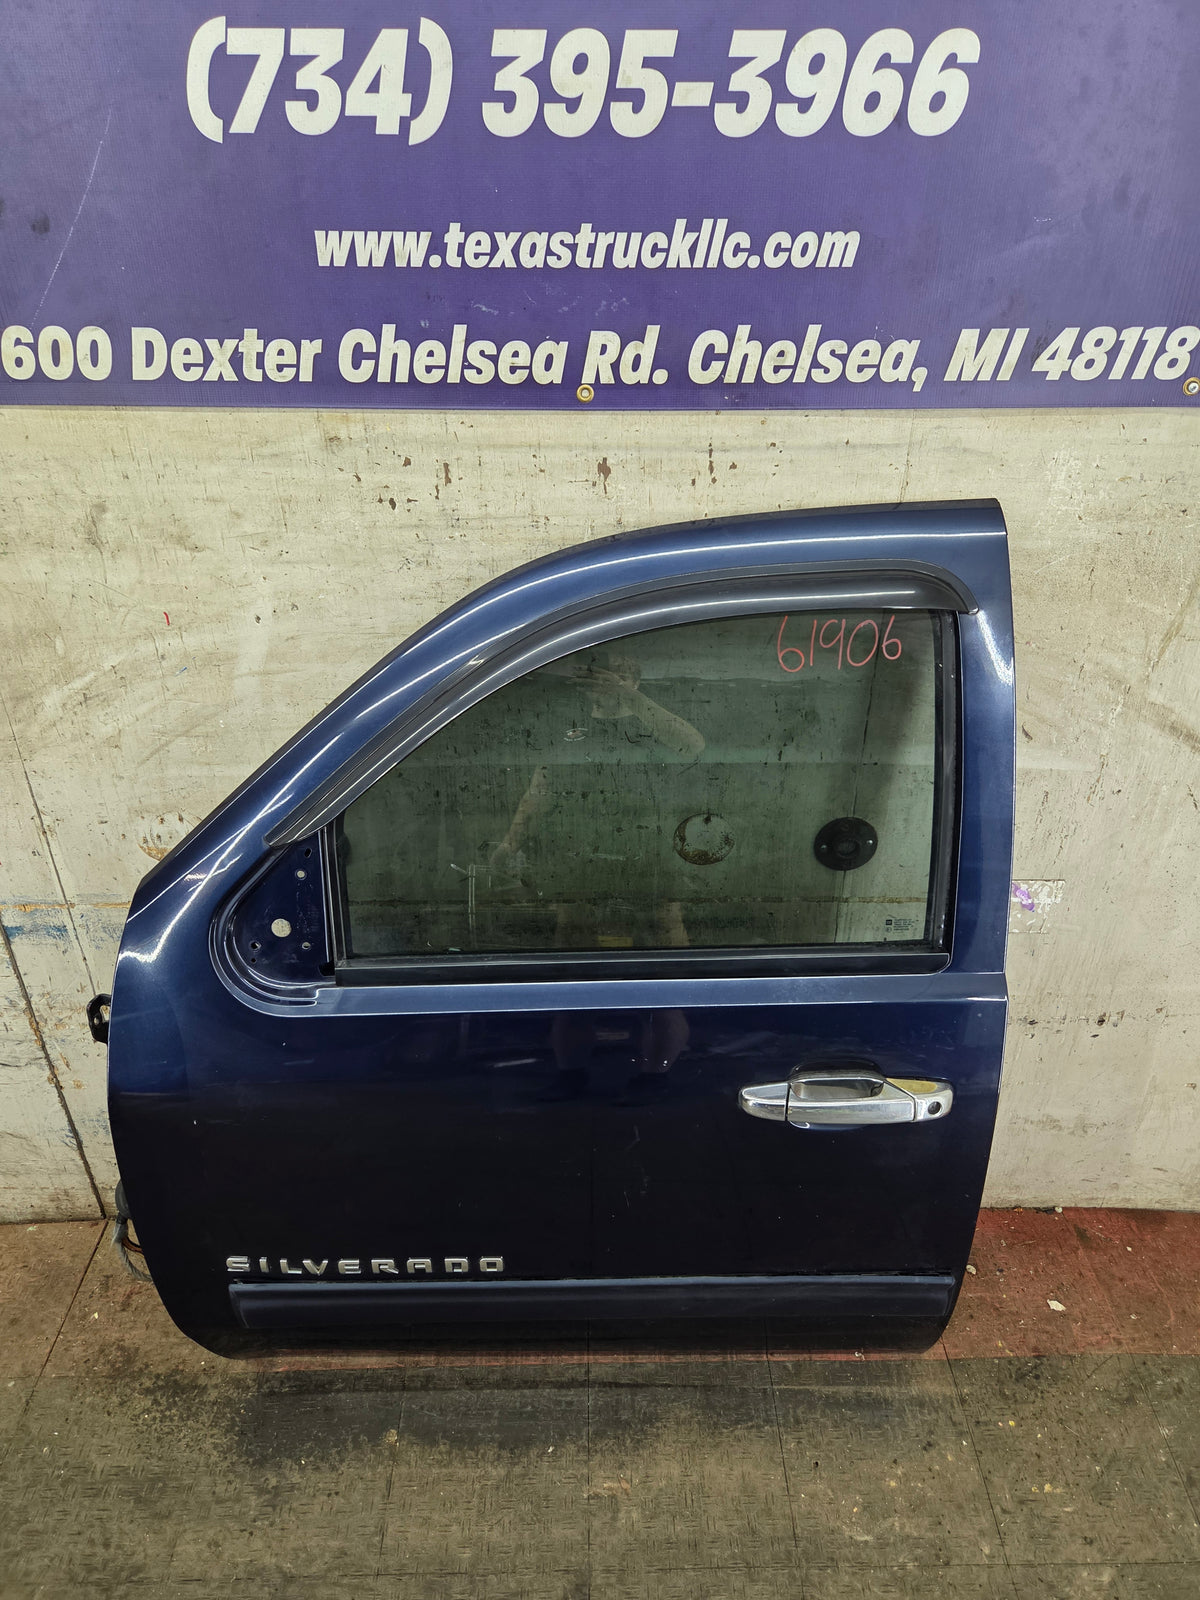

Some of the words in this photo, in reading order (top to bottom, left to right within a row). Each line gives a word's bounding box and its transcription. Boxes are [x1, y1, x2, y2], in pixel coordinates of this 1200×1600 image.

[187, 16, 453, 145] (734)
[482, 28, 980, 138] 395-3966
[314, 218, 860, 269] www.texastruckllc.com
[1, 326, 112, 380] 600
[131, 327, 322, 383] Dexter
[338, 323, 569, 384] Chelsea
[581, 325, 669, 385] Rd.
[688, 324, 928, 392] Chelsea,
[944, 328, 1029, 382] MI
[1031, 325, 1200, 381] 48118
[777, 614, 902, 672] 61906
[226, 1255, 504, 1276] SILVERADO
